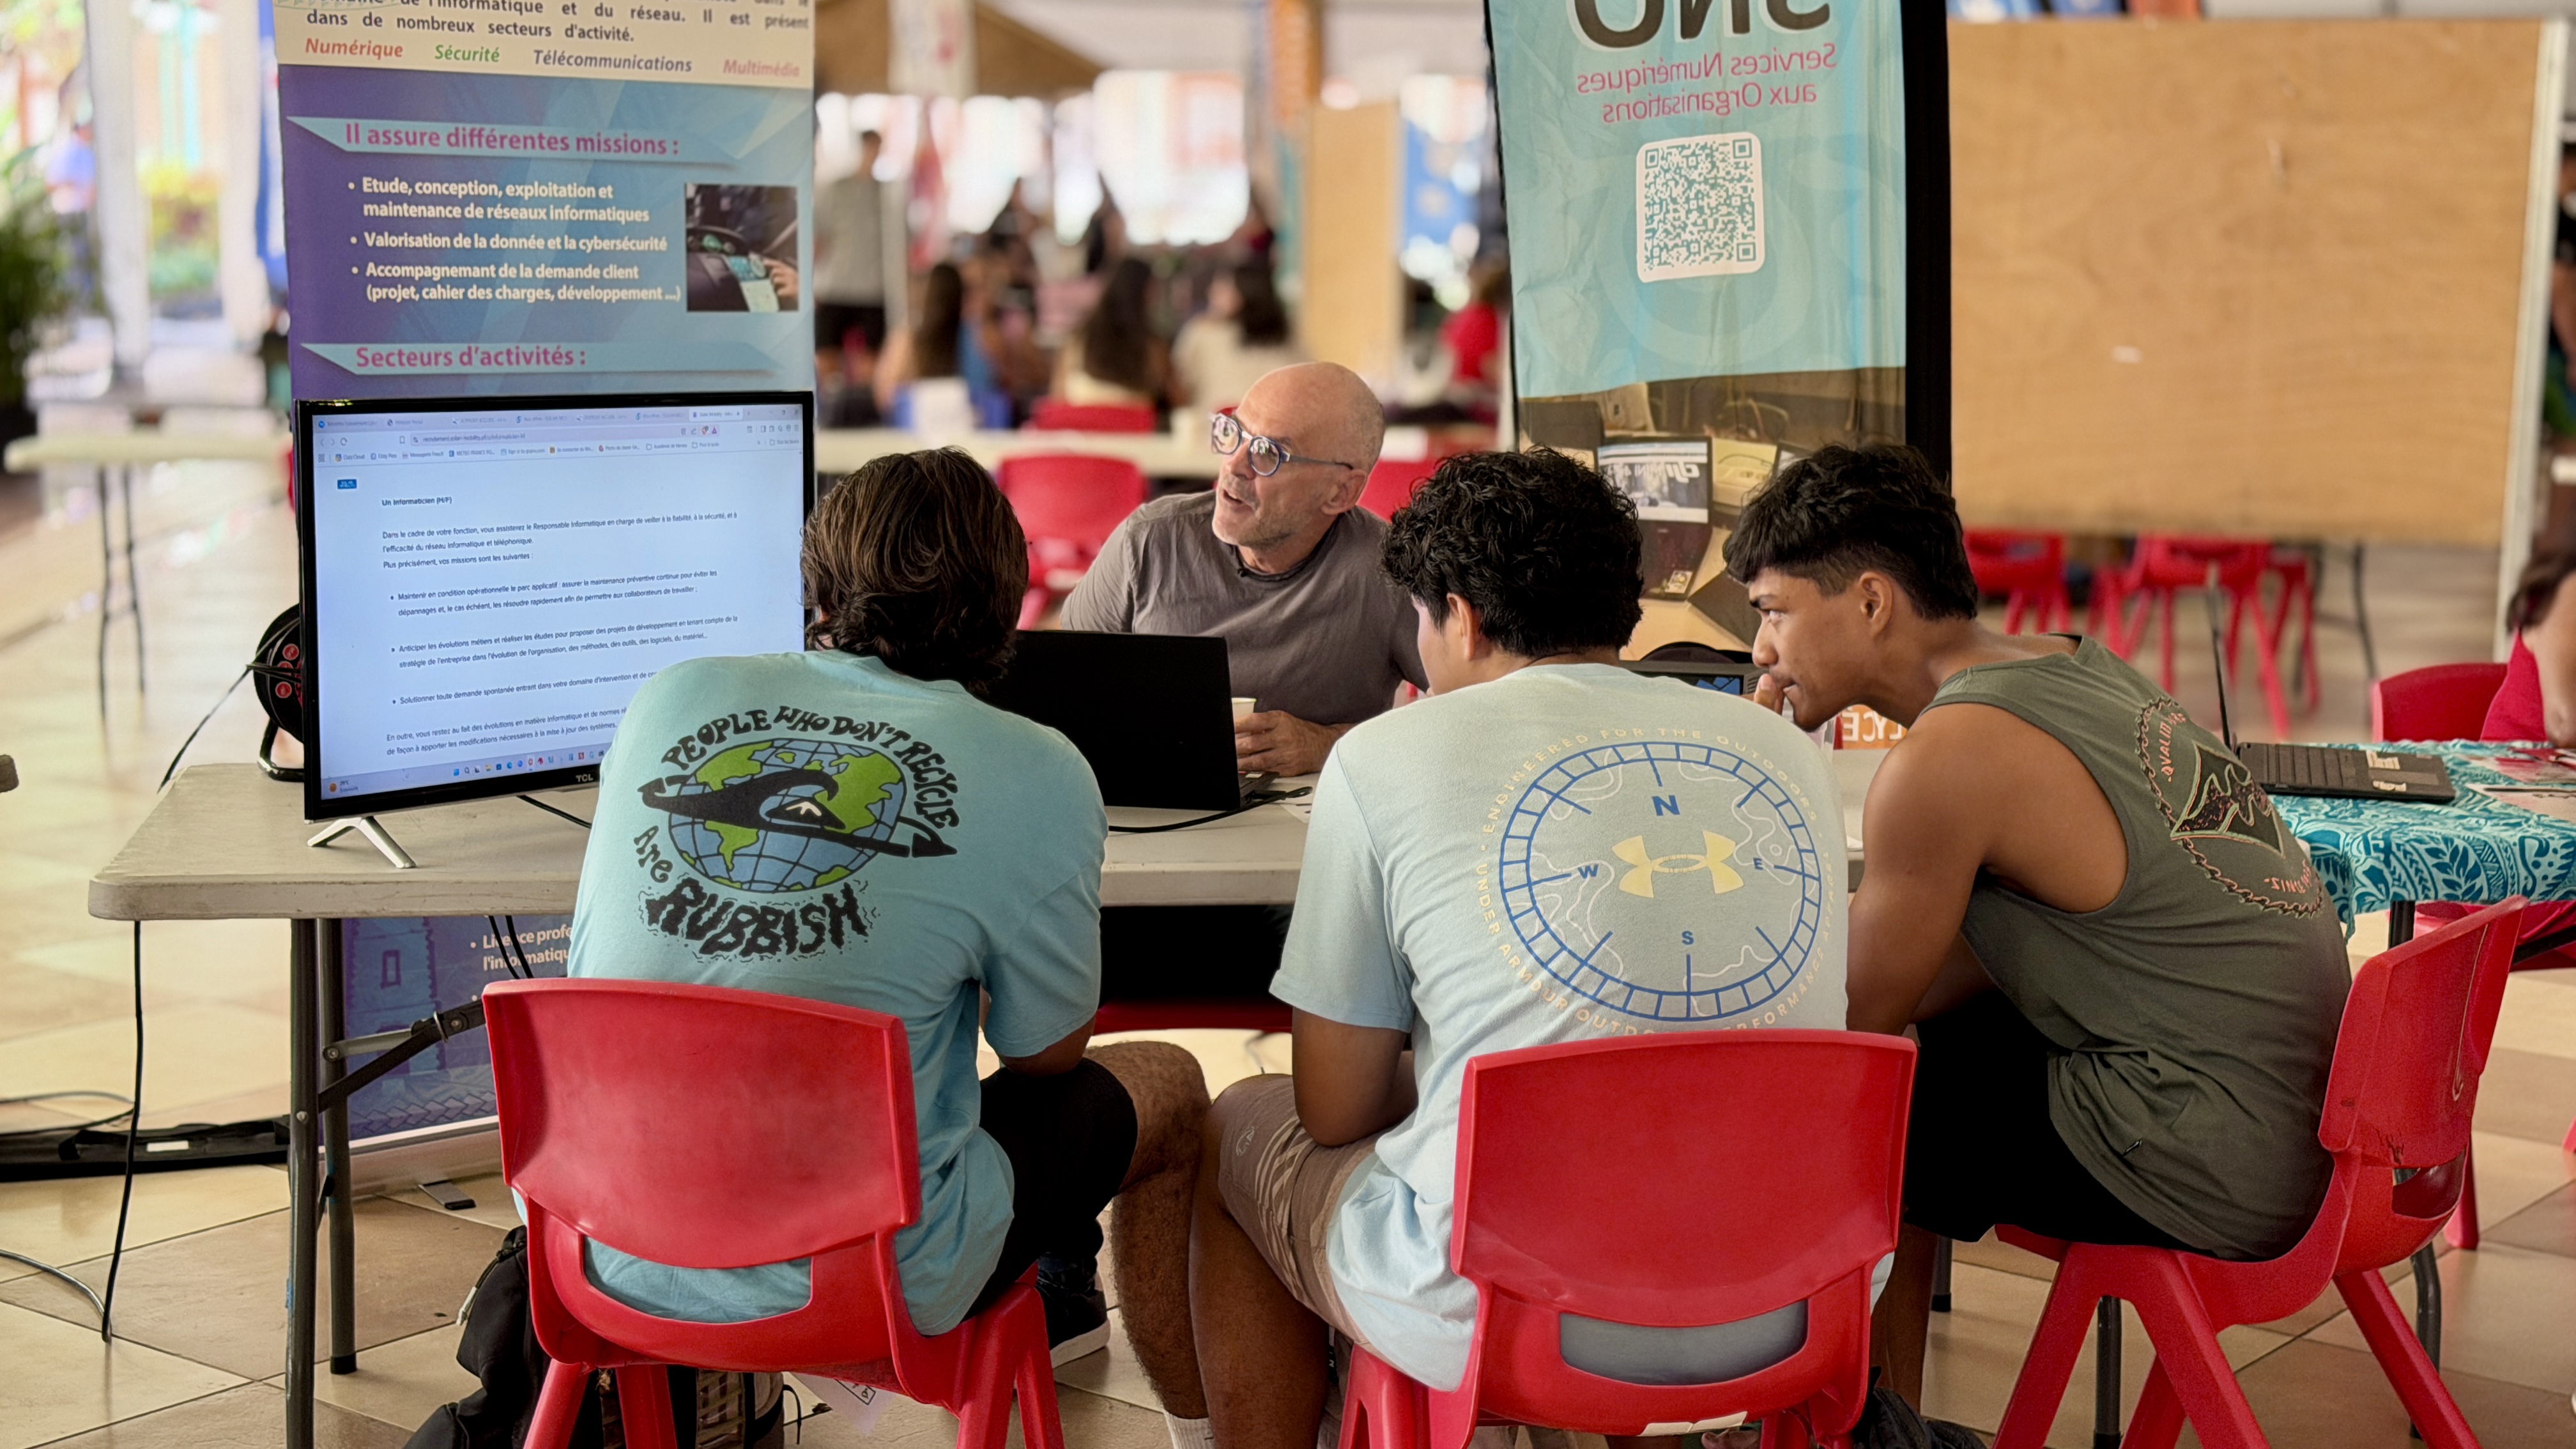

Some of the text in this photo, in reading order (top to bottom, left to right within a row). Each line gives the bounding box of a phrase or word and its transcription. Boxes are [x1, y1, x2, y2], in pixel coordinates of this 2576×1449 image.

[562, 2, 578, 16] et
[594, 3, 614, 18] du
[630, 6, 686, 22] réseau.
[703, 8, 713, 24] Il
[730, 13, 751, 26] est
[306, 10, 634, 41] dans de nombreux secteurs d'activité.
[305, 38, 403, 59] Numérique
[434, 44, 500, 62] Sécurité
[533, 49, 692, 72] Télécommunications
[346, 122, 360, 144] Il
[367, 129, 440, 146] assure
[446, 127, 570, 150] différentes
[575, 132, 666, 154] missions
[362, 177, 612, 199] Etude, conception, exploitation et
[363, 201, 648, 223] maintenance de réseaux informatiques
[364, 231, 666, 252] Valorisation de la donnée et la cybersécurité
[365, 263, 638, 280] Accompagnemant de la demande client
[367, 284, 682, 303] (projet, cahier des charges, développement ...)
[356, 347, 453, 367] Secteurs
[661, 709, 772, 770] PEOPLE
[773, 705, 830, 732] WHO
[898, 741, 960, 829] RECYCLE
[576, 774, 594, 783] TCL
[1482, 727, 1818, 834] ENGINEERED FOR THE OUTDOORS
[1651, 795, 1681, 817] N
[1577, 864, 1600, 880] W
[1752, 857, 1764, 870] E
[645, 877, 870, 958] RUBBISH
[1475, 862, 1501, 936] UNDER
[1498, 943, 1568, 1011] ARMOUR
[1681, 930, 1695, 946] S
